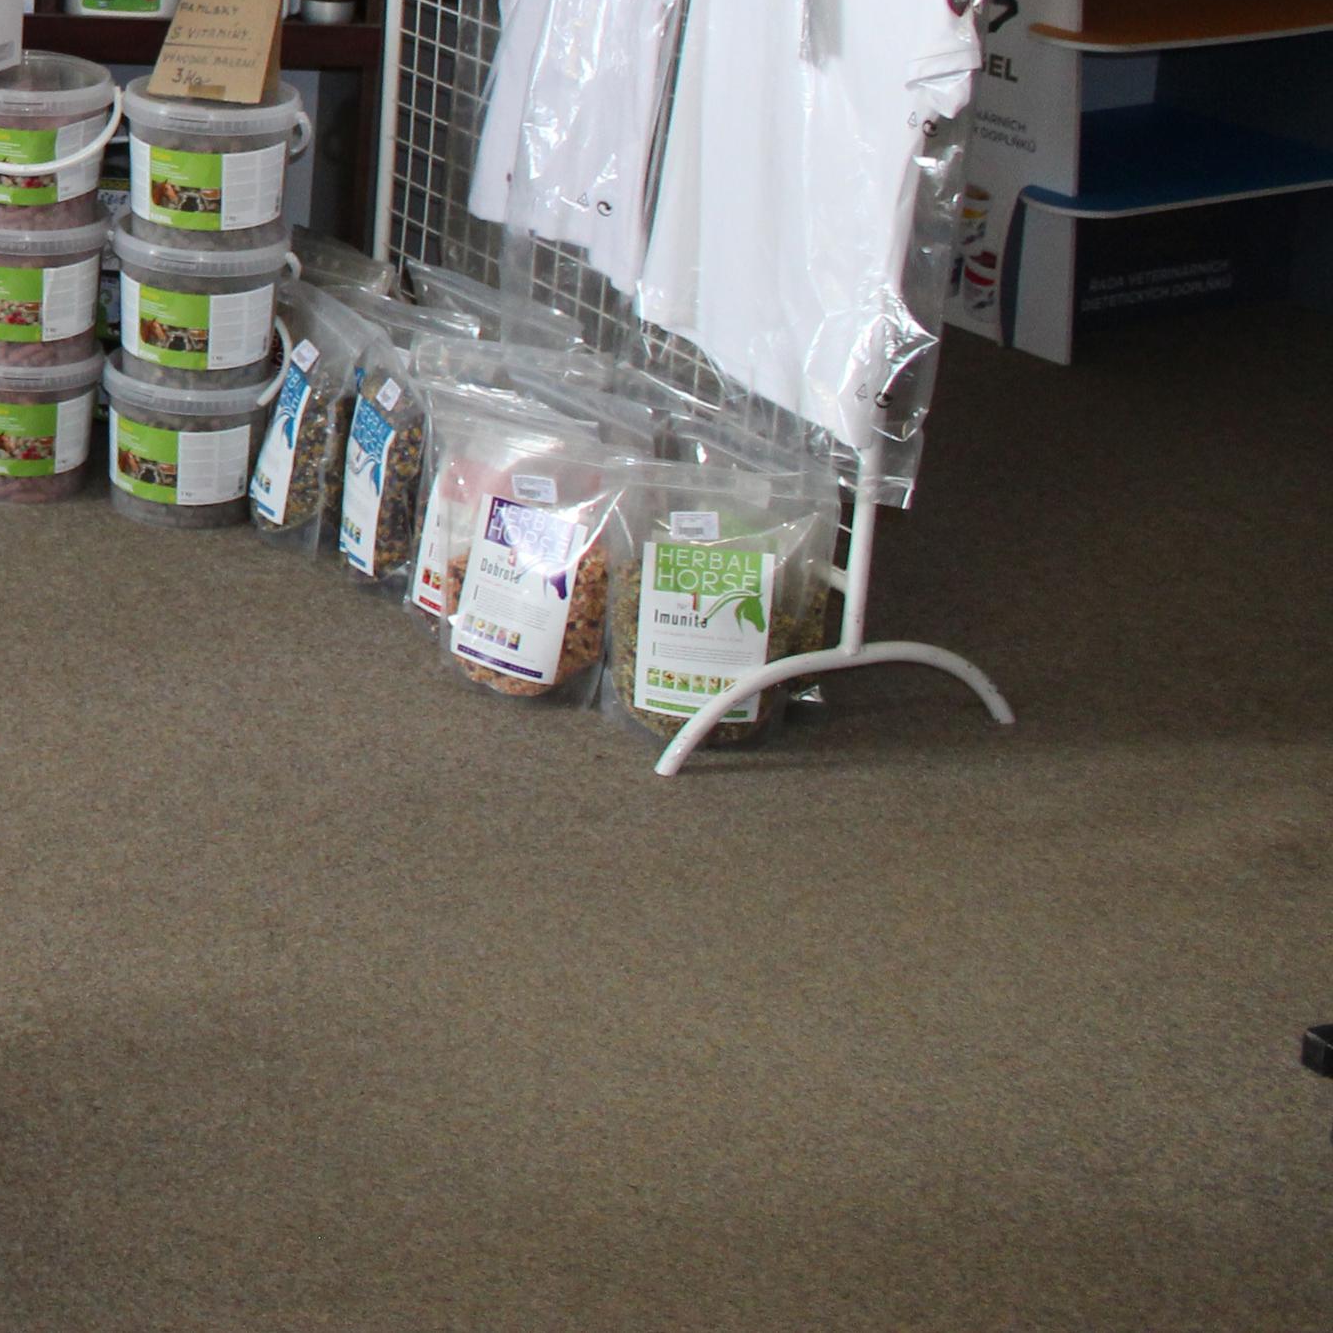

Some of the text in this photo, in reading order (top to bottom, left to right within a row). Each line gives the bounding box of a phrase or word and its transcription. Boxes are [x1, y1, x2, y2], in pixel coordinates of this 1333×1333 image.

[658, 547, 758, 575] HERBAL
[657, 569, 758, 595] HORSE
[653, 609, 708, 629] Imunita
